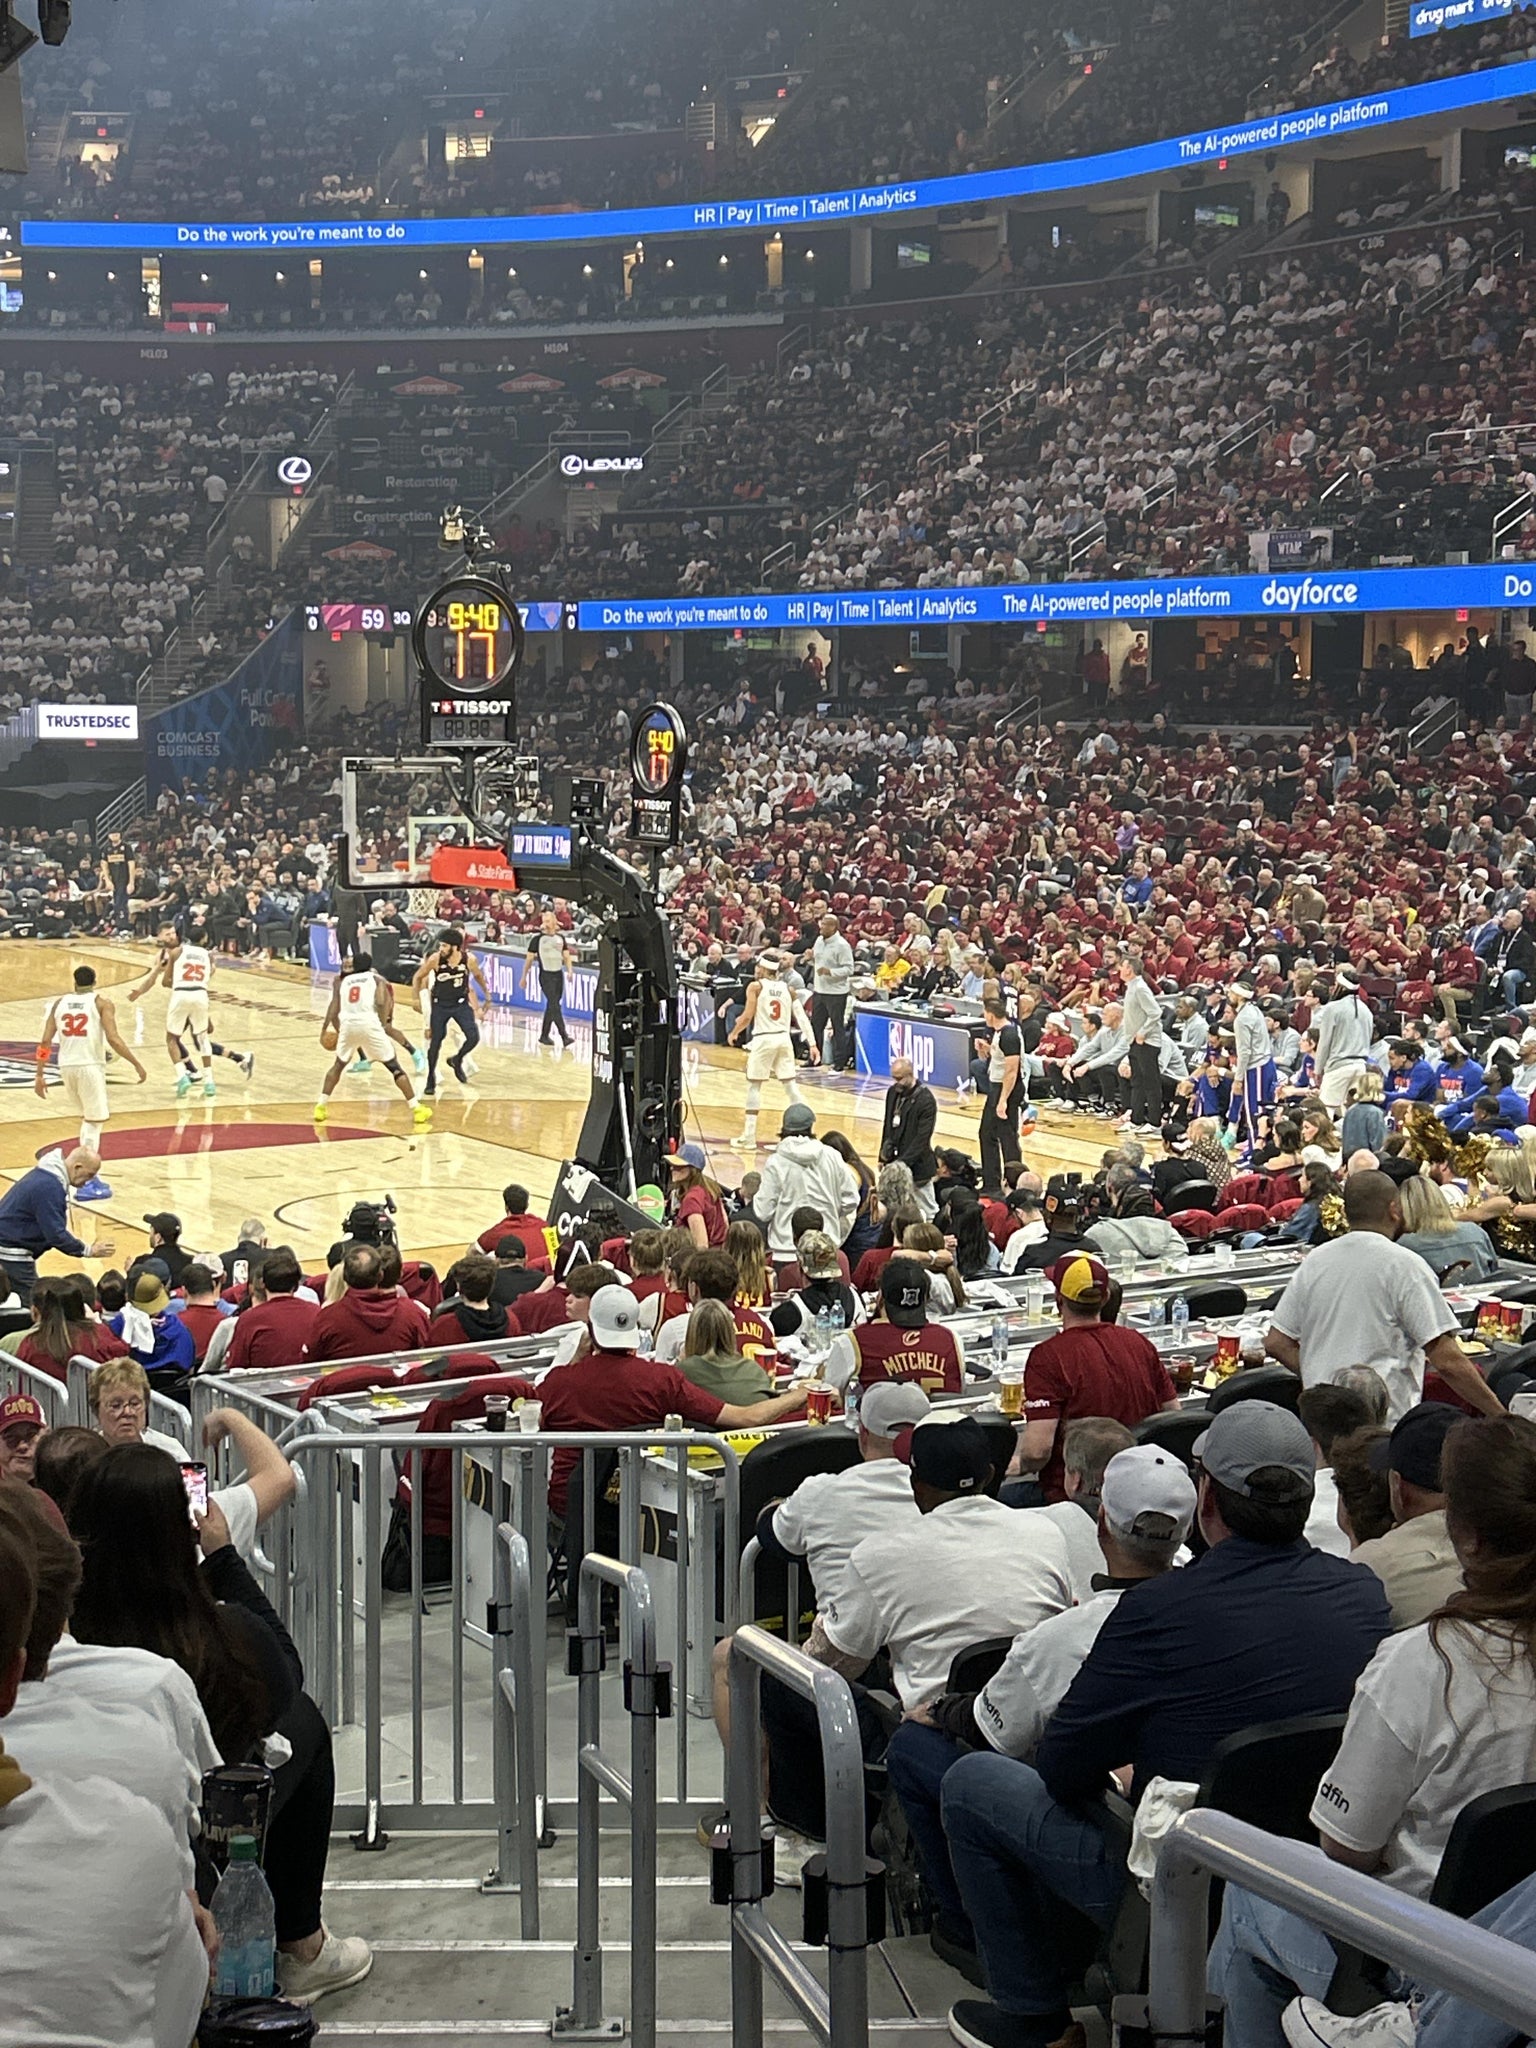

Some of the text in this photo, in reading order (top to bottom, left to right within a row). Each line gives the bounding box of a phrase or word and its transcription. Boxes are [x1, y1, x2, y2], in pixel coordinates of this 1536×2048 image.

[1416, 8, 1444, 25] drug
[1445, 1, 1474, 18] mart
[1179, 101, 1389, 157] The AI-powered people platform
[694, 188, 917, 224] HR Pay Time Talent Analytics
[177, 223, 405, 244] Do the work you're meant to do
[584, 458, 643, 470] LEXUS
[1261, 577, 1358, 611] dayforce
[1504, 575, 1532, 597] Do
[787, 595, 977, 623] HR Pay Time Talent Analytics
[1003, 586, 1231, 616] The AI-powered people platform
[308, 616, 317, 631] 0
[361, 608, 385, 630] 59
[393, 611, 411, 625] 3Q
[448, 603, 499, 631] 9:40
[567, 614, 575, 629] 0
[603, 602, 768, 626] Do the work you're meant to do
[456, 630, 495, 680] 17
[452, 700, 512, 714] TISSOT
[46, 715, 131, 728] TRUSTEDSEC
[157, 732, 221, 743] COMCAST
[157, 745, 221, 757] BUSINESS
[651, 754, 668, 782] 17
[645, 800, 672, 811] TISSOT
[182, 963, 206, 982] 25
[348, 986, 361, 1003] 8
[493, 957, 513, 1003] App
[563, 970, 598, 1013] WATC
[769, 1000, 781, 1021] 3
[61, 1013, 89, 1037] 32
[903, 1024, 935, 1082] App
[733, 1321, 764, 1340] LAND
[881, 1351, 946, 1377] MITCHELL
[4, 1398, 34, 1417] CAVS
[1320, 1782, 1350, 1815] dfin
